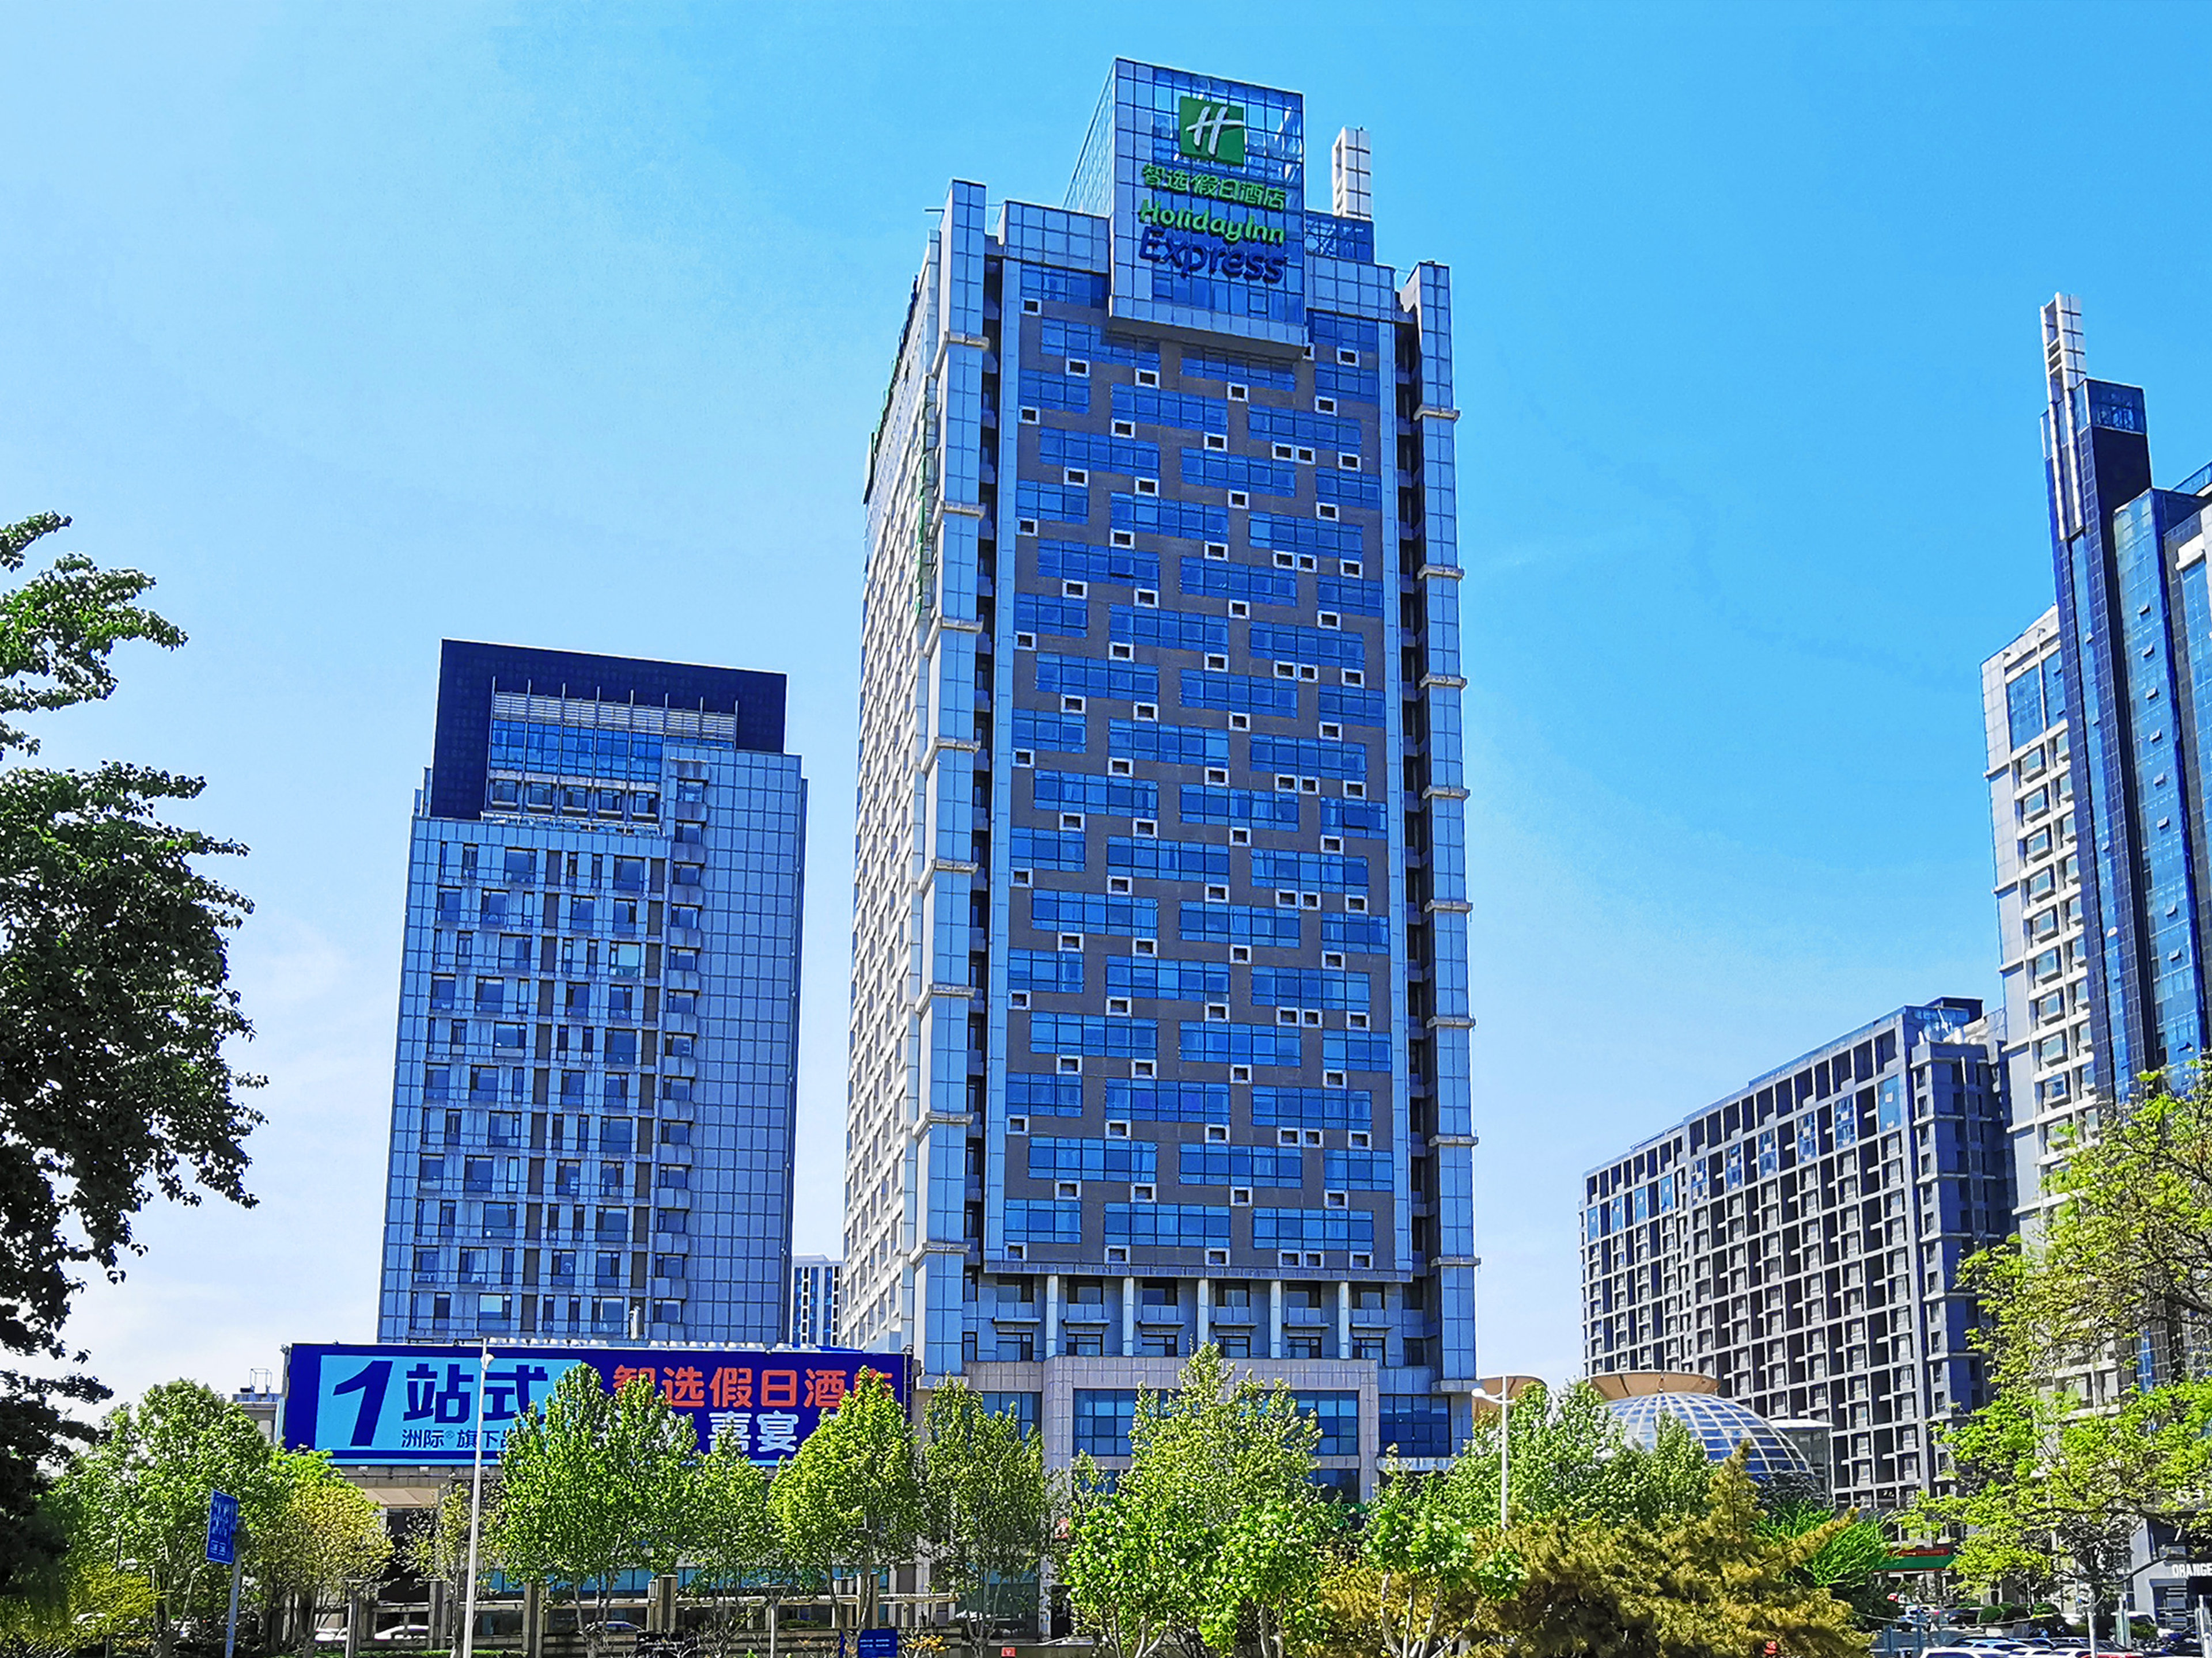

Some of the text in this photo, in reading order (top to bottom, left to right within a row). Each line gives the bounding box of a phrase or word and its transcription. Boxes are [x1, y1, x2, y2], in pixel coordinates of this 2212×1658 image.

[1141, 163, 1286, 211] 智选假日酒店
[612, 1364, 893, 1408] 选假日酒
